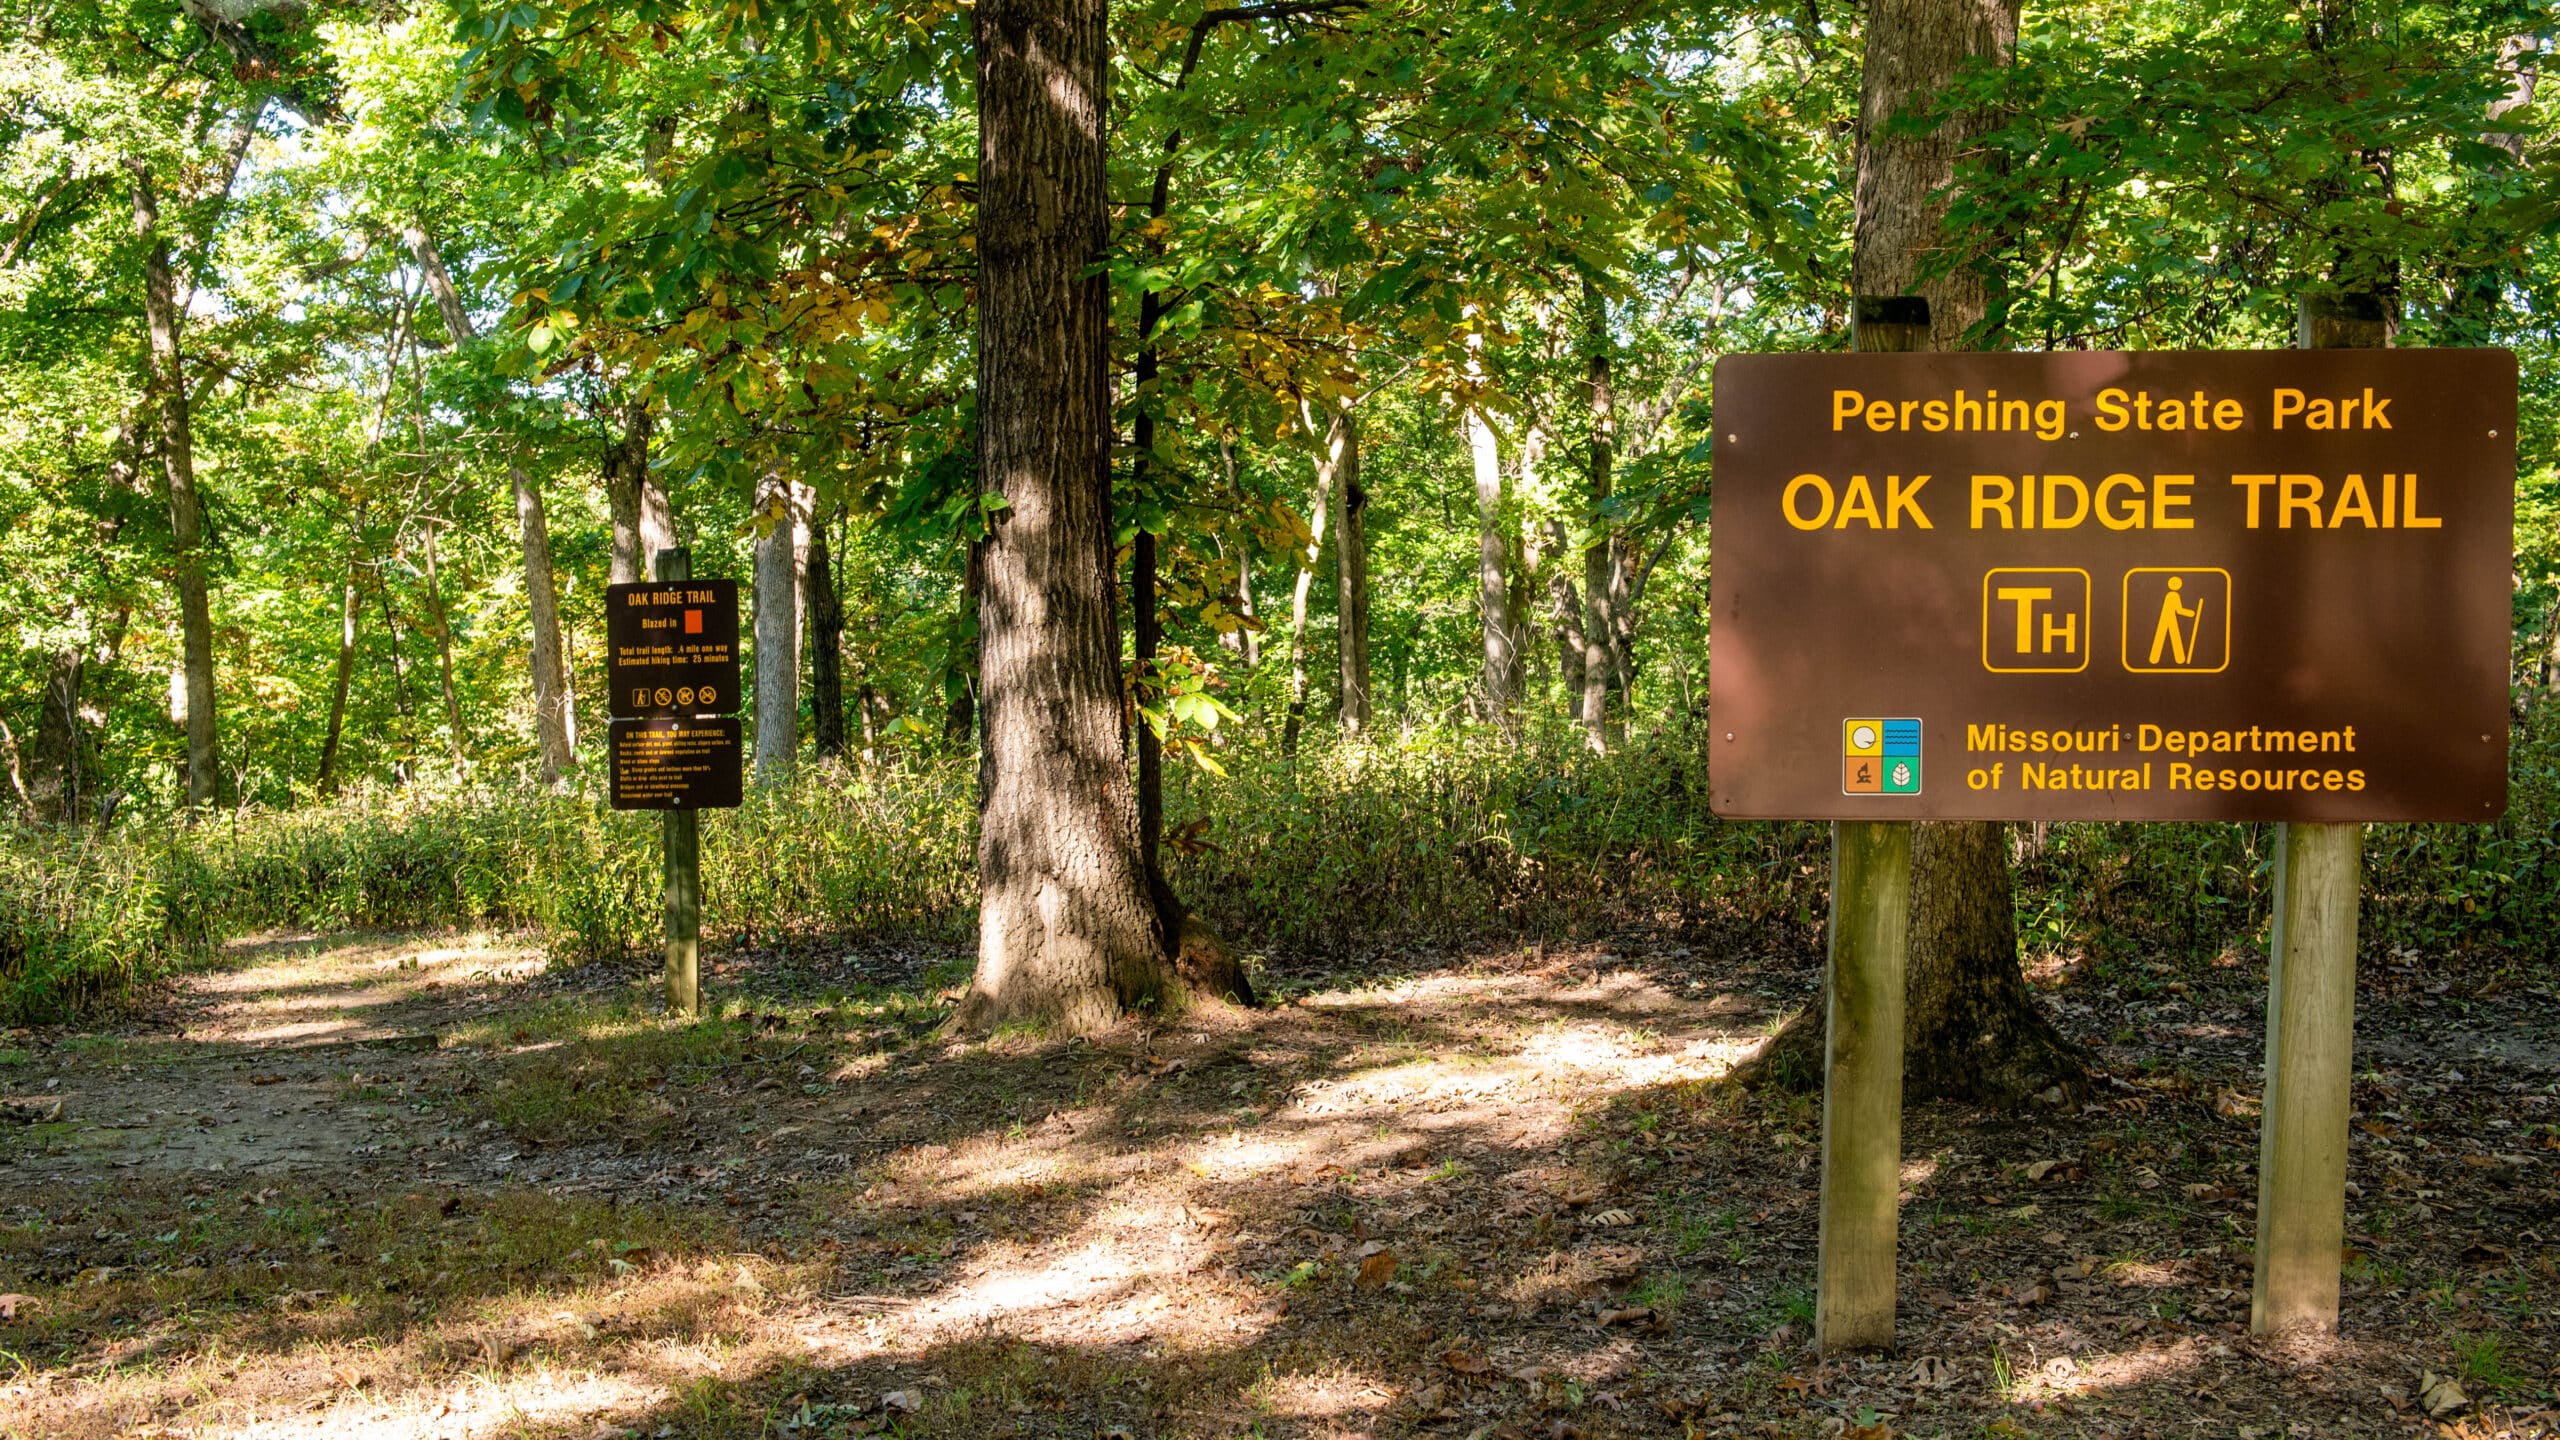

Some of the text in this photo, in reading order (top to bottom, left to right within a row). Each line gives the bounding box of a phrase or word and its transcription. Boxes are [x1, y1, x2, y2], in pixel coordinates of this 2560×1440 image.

[1832, 387, 2393, 442] Pershing State Park
[1781, 472, 2443, 532] OAK RIDGE TRAIL
[628, 590, 716, 606] OAK RIDGE TRAIL
[642, 617, 677, 629] Blazed in
[619, 647, 635, 657] Total
[637, 646, 649, 656] trail
[652, 645, 673, 656] length:
[686, 645, 699, 654] mile
[715, 645, 728, 654] way
[619, 654, 729, 667] Estimated hiking time: 25 minutes
[667, 729, 677, 738] YOU
[1967, 723, 2356, 758] Missouri Department
[1966, 761, 2366, 792] of Natural Resources
